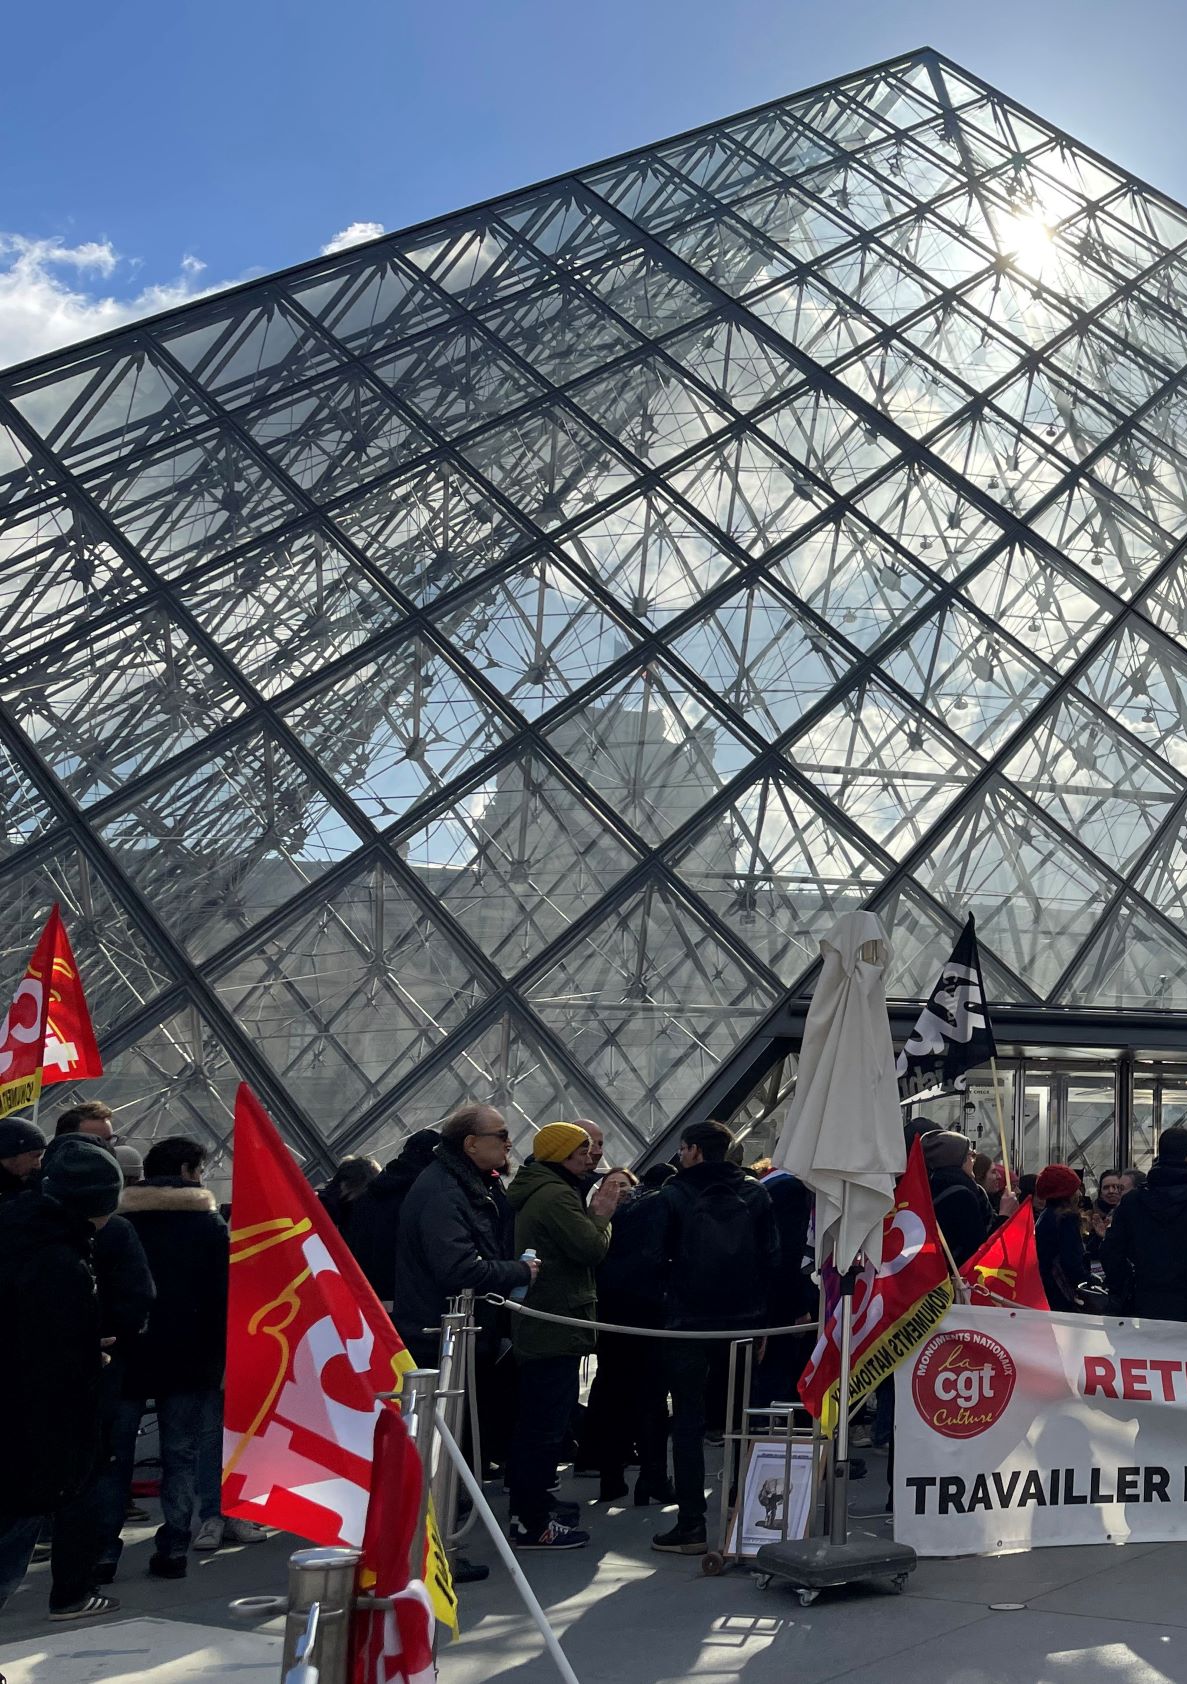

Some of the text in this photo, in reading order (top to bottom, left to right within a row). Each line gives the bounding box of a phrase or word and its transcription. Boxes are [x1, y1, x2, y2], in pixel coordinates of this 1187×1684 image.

[938, 1345, 994, 1371] la
[973, 1334, 1013, 1376] NATIONAUX
[934, 1363, 996, 1408] cgt
[933, 1408, 993, 1426] Culture
[905, 1465, 1171, 1515] TRAVAILLER
